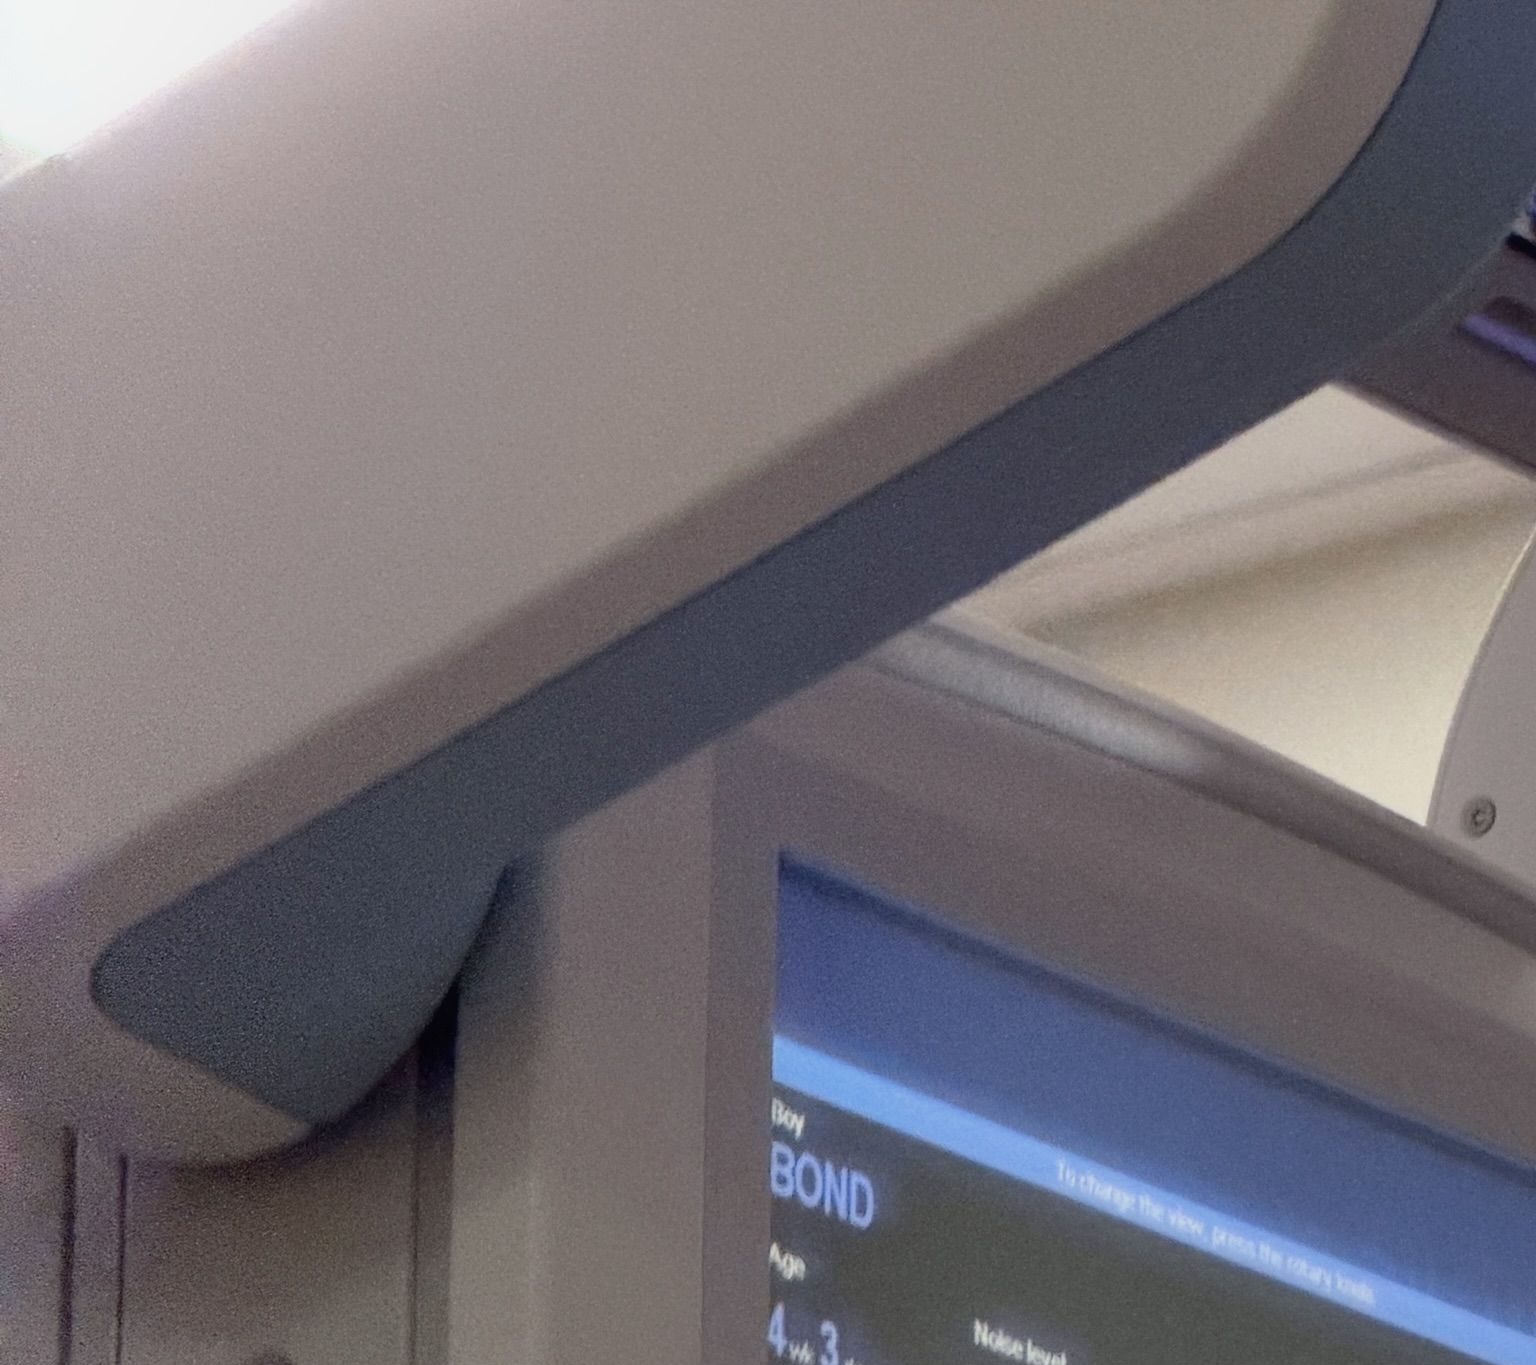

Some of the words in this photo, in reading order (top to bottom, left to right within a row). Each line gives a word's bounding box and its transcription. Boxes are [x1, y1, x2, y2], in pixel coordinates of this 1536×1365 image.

[771, 1097, 805, 1139] Boy
[770, 1141, 874, 1230] BOND
[769, 1241, 806, 1280] Age
[767, 1301, 787, 1357] 4
[974, 1318, 1023, 1361] Noise
